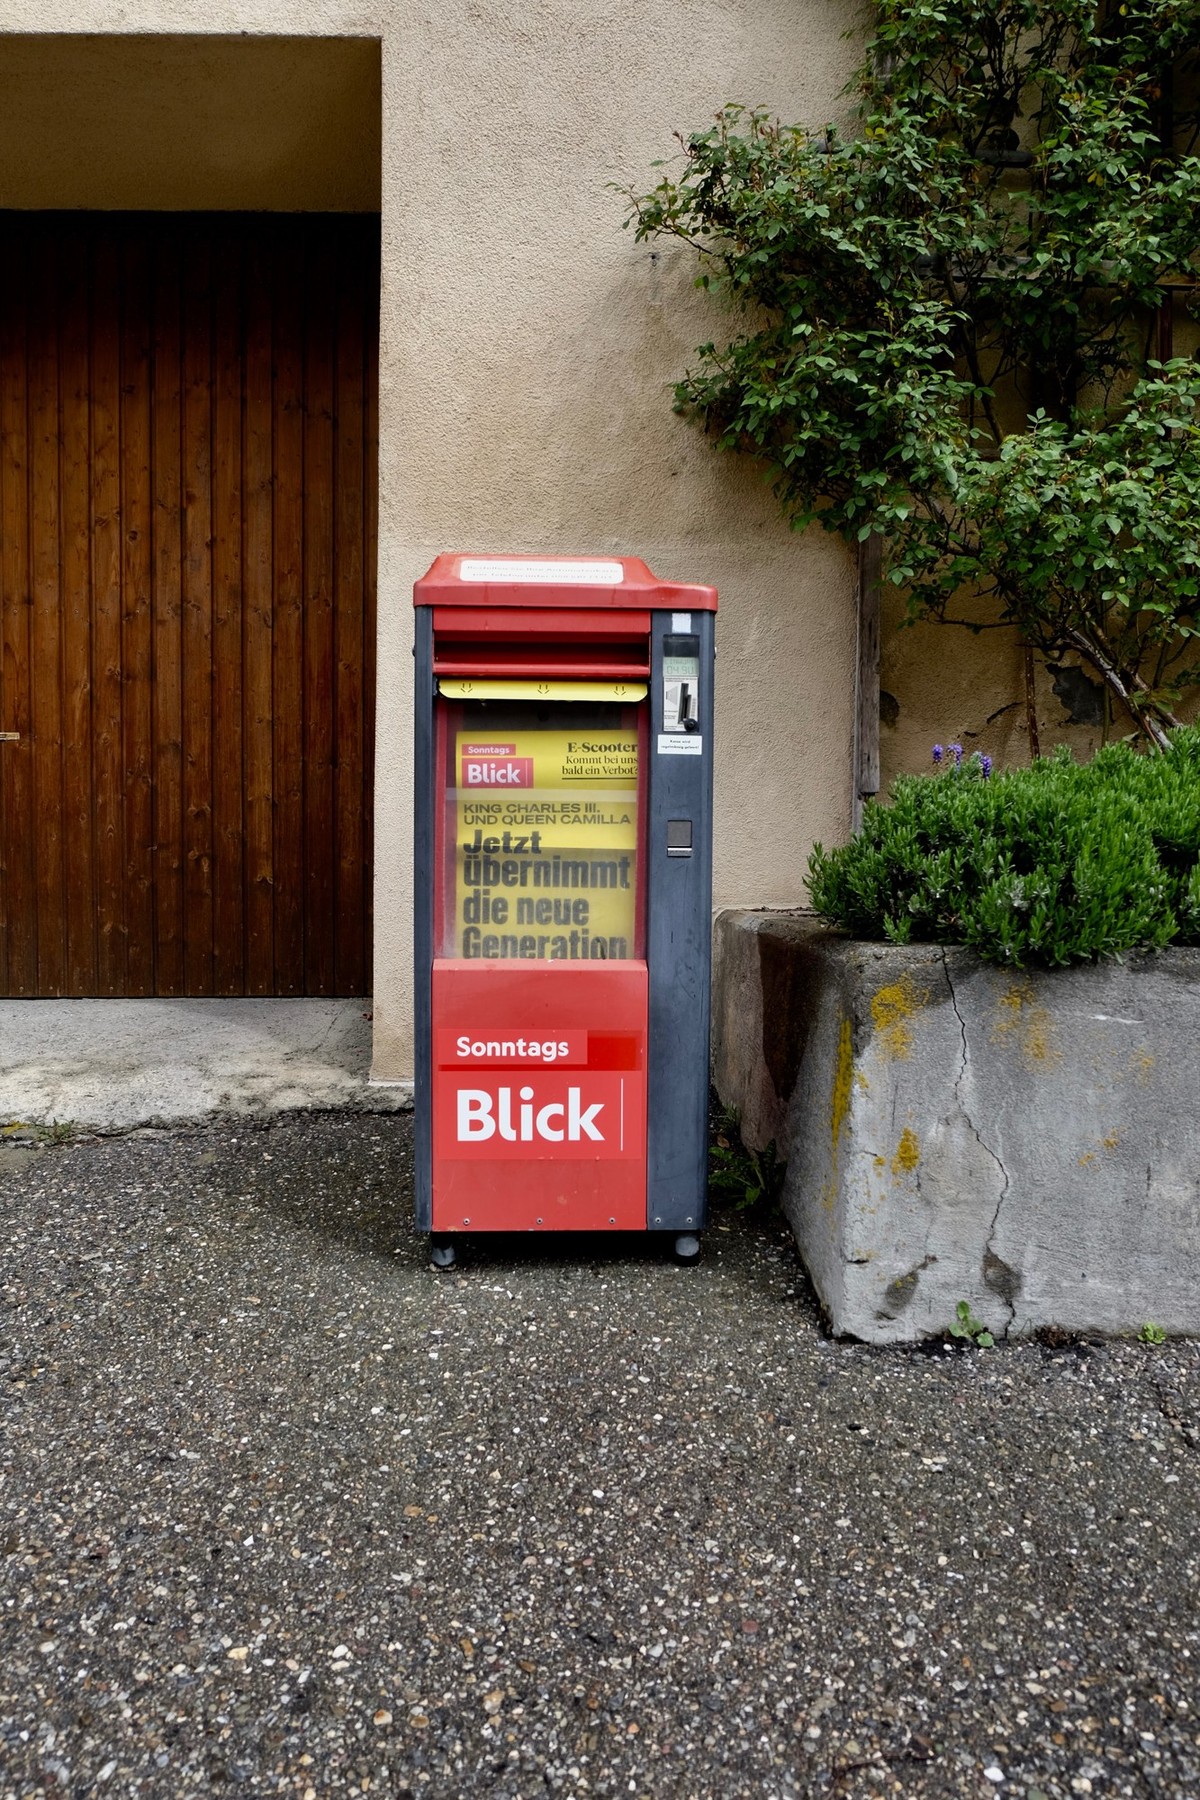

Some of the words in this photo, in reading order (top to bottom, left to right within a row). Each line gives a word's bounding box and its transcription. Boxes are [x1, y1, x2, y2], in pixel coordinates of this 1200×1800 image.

[468, 746, 510, 756] Sonntags
[567, 742, 638, 753] E-Scooter
[561, 766, 583, 775] bald
[584, 766, 600, 775] ein
[602, 766, 638, 775] Verbot?
[566, 755, 602, 764] Kommt
[604, 755, 619, 764] bei
[620, 757, 638, 765] uns
[467, 763, 521, 784] Blick
[464, 803, 502, 813] KING
[506, 803, 581, 814] CHARLES
[584, 803, 601, 813] III.
[464, 815, 498, 825] UND
[501, 814, 557, 825] QUEEN
[560, 814, 631, 825] CAMILLA
[463, 829, 542, 854] Jetzt
[463, 855, 631, 889] übernimmt
[463, 888, 509, 925] die
[517, 897, 589, 926] neue
[462, 926, 627, 960] Generation
[456, 1036, 569, 1062] Sonntags
[456, 1086, 606, 1142] Blick
